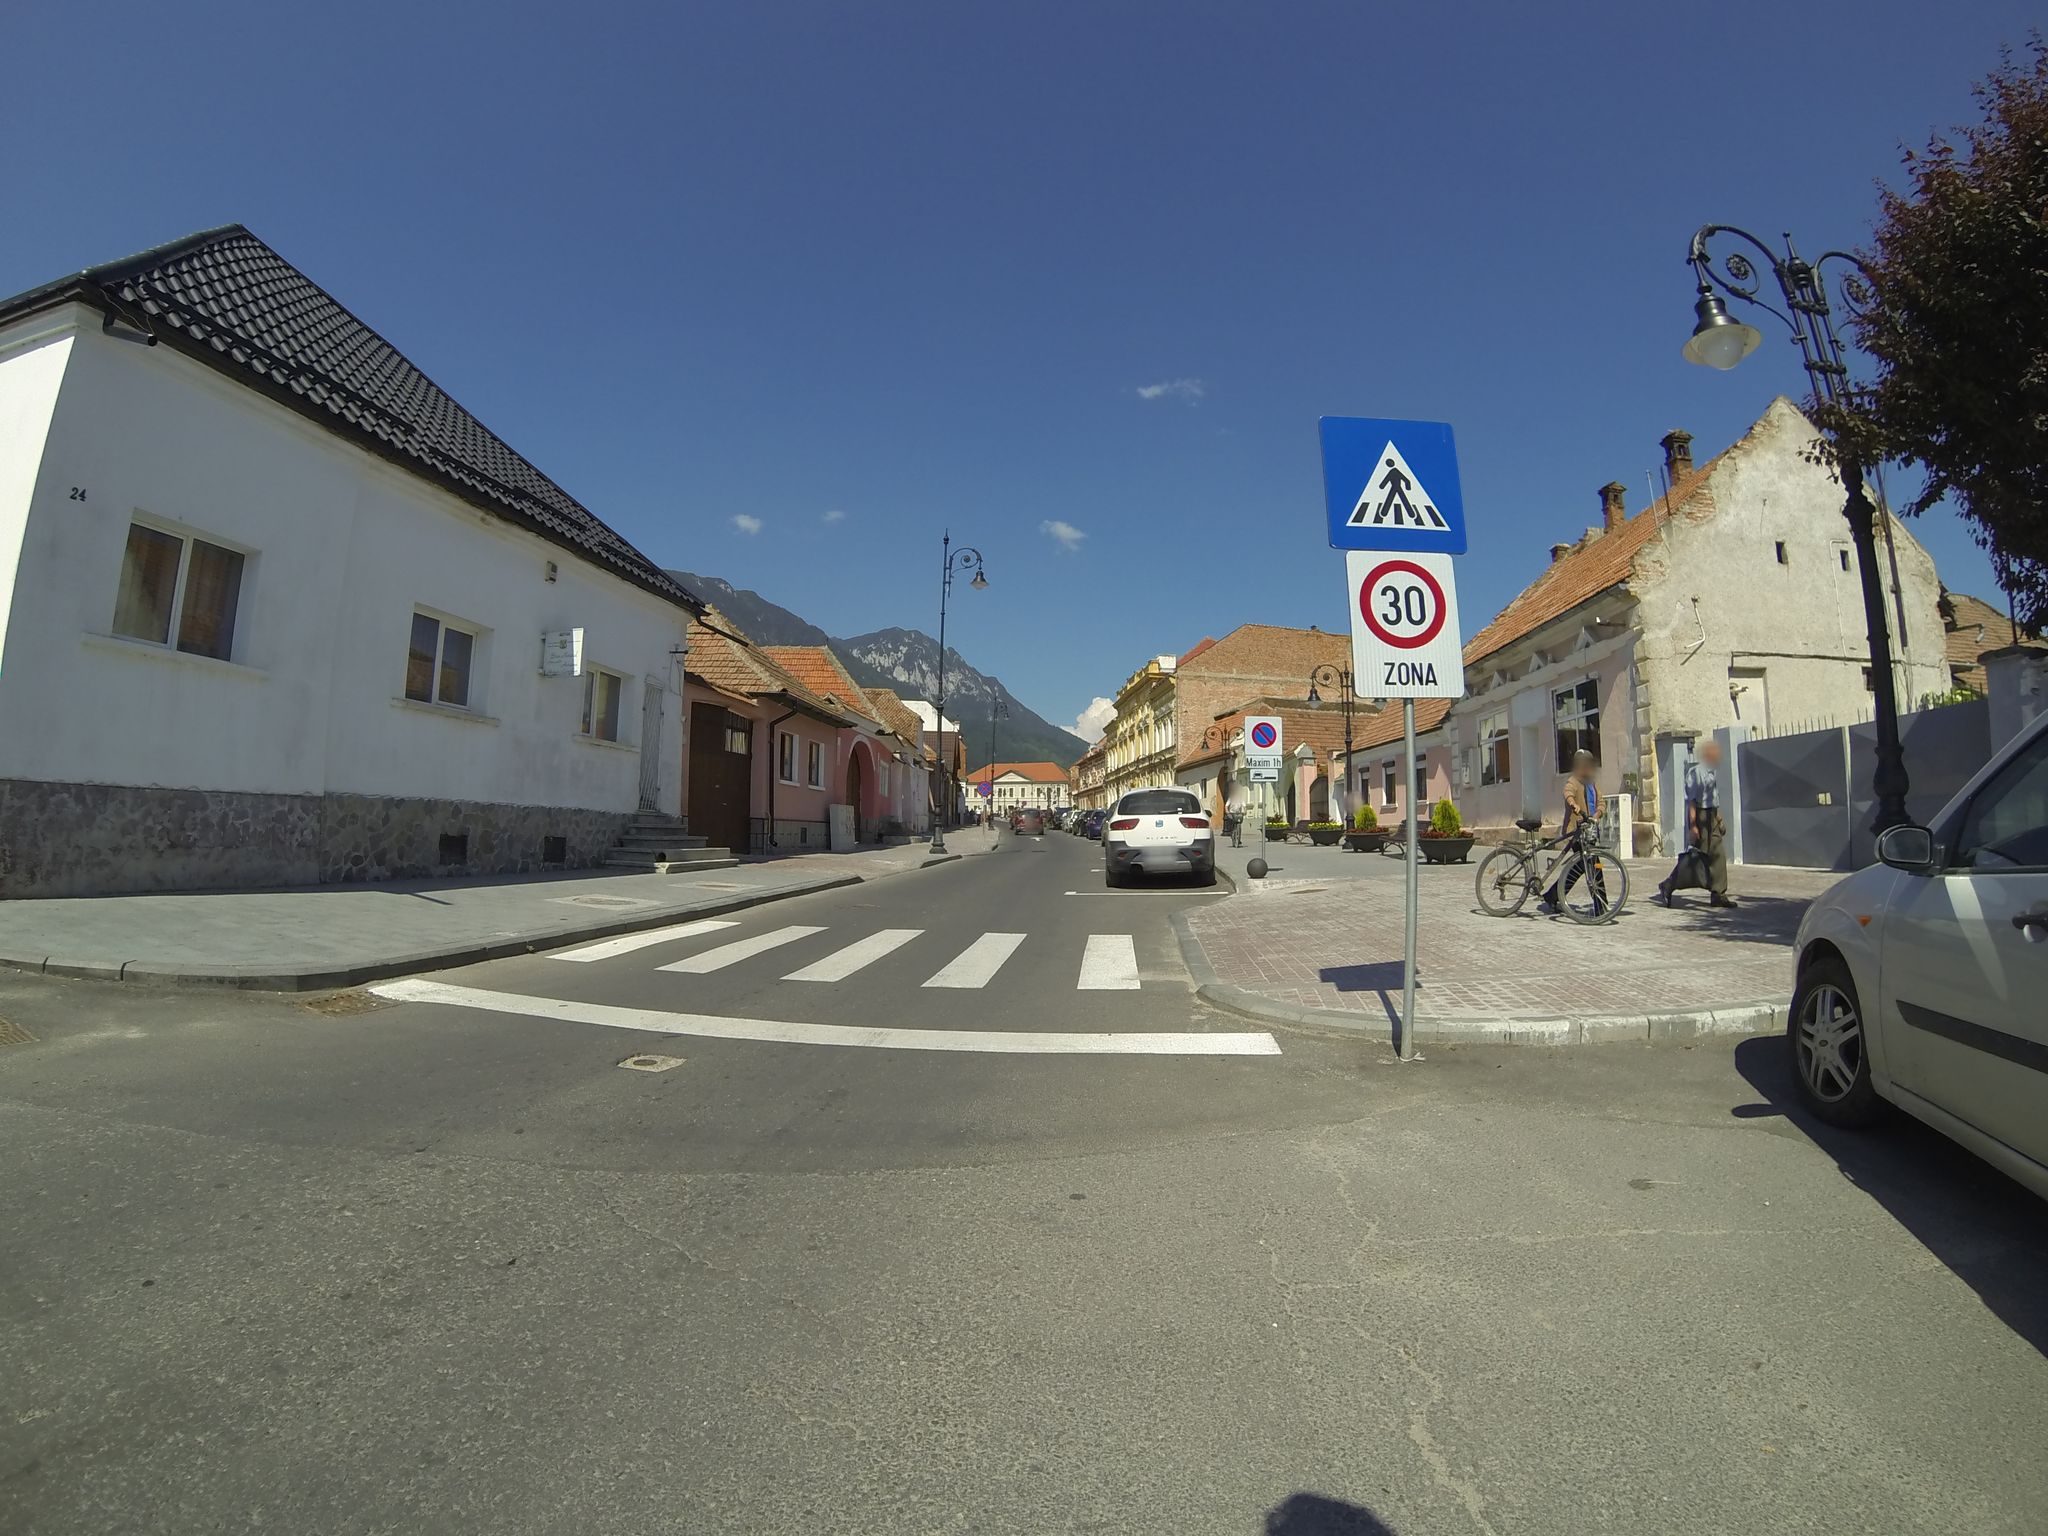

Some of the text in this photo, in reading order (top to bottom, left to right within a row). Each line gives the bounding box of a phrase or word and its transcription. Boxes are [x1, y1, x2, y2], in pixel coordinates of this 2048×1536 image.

[70, 486, 87, 502] 24
[1380, 585, 1426, 626] 30
[1383, 662, 1438, 686] ZONA
[1246, 757, 1282, 767] Maxim 1h
